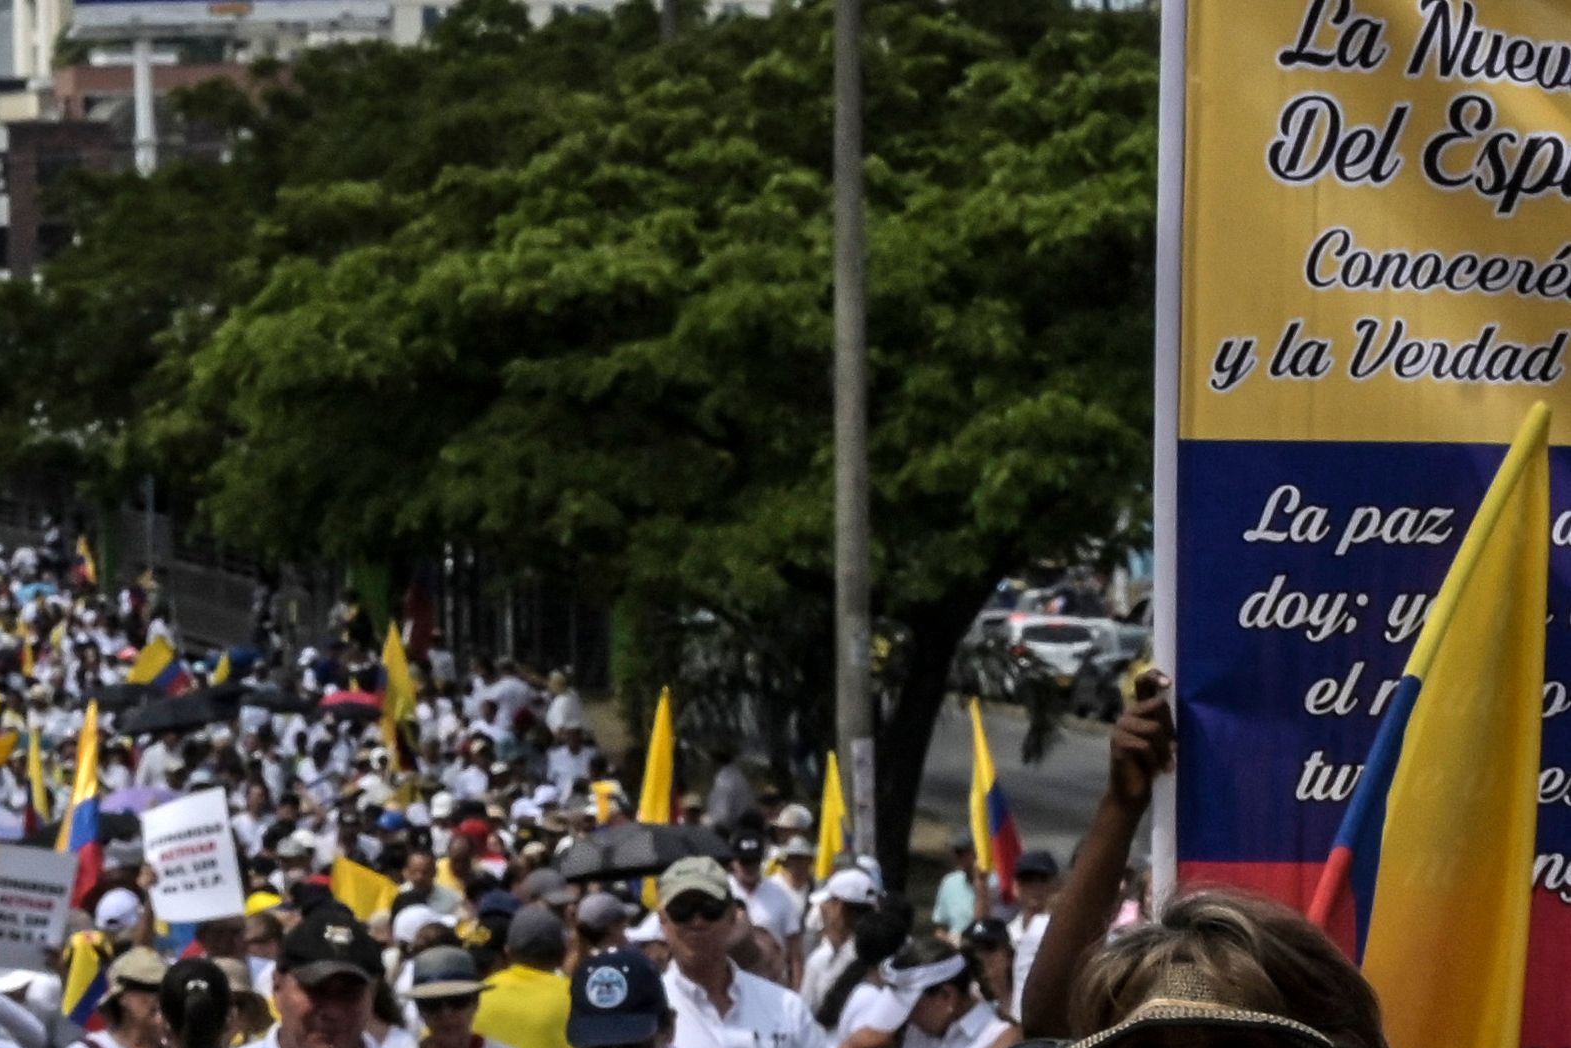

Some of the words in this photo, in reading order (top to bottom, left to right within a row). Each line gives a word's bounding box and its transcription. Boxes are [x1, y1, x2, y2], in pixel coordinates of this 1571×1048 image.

[1279, 0, 1386, 69] La
[1268, 96, 1408, 183] Del
[1423, 95, 1571, 214] Esp
[1306, 229, 1571, 298] Conoceré
[1211, 340, 1254, 390] y
[1270, 322, 1329, 378] la
[1350, 319, 1569, 382] Verdad
[1243, 484, 1330, 543] La
[1335, 506, 1455, 556] paz
[1239, 575, 1368, 642] doy;
[1304, 661, 1363, 716] el
